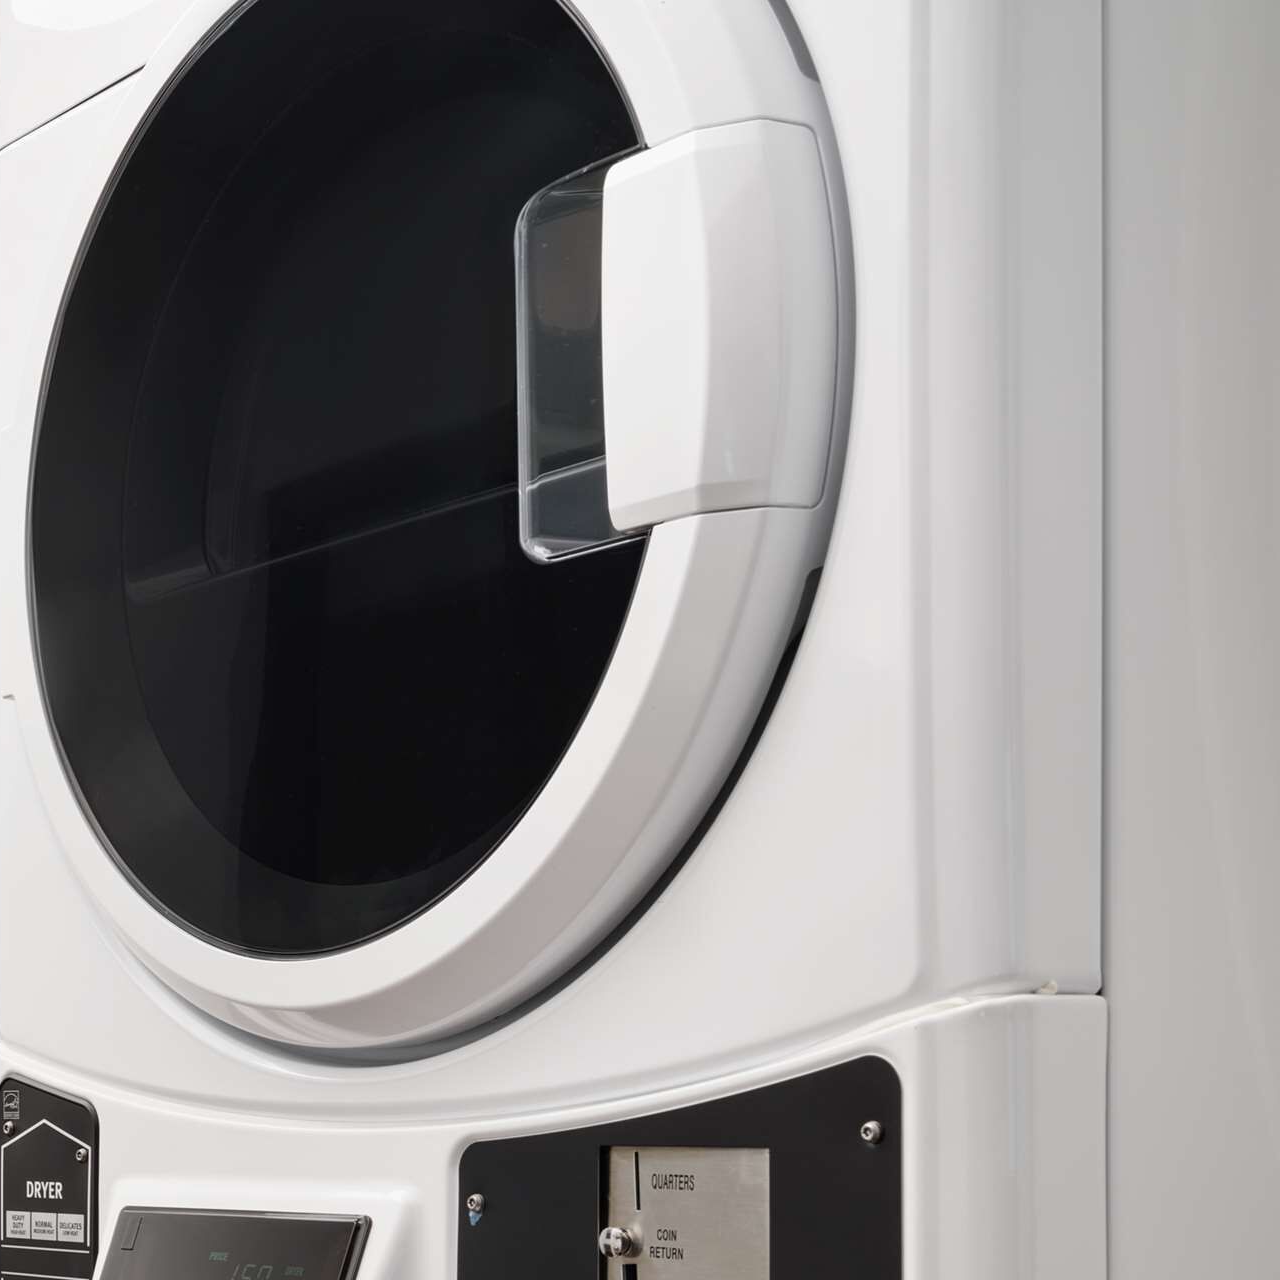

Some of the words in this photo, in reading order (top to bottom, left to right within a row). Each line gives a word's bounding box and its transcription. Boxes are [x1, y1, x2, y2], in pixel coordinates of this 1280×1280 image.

[26, 1180, 63, 1200] DRYER
[651, 1173, 695, 1191] QUARTERS
[656, 1229, 678, 1241] COIN
[649, 1246, 684, 1260] RETURN
